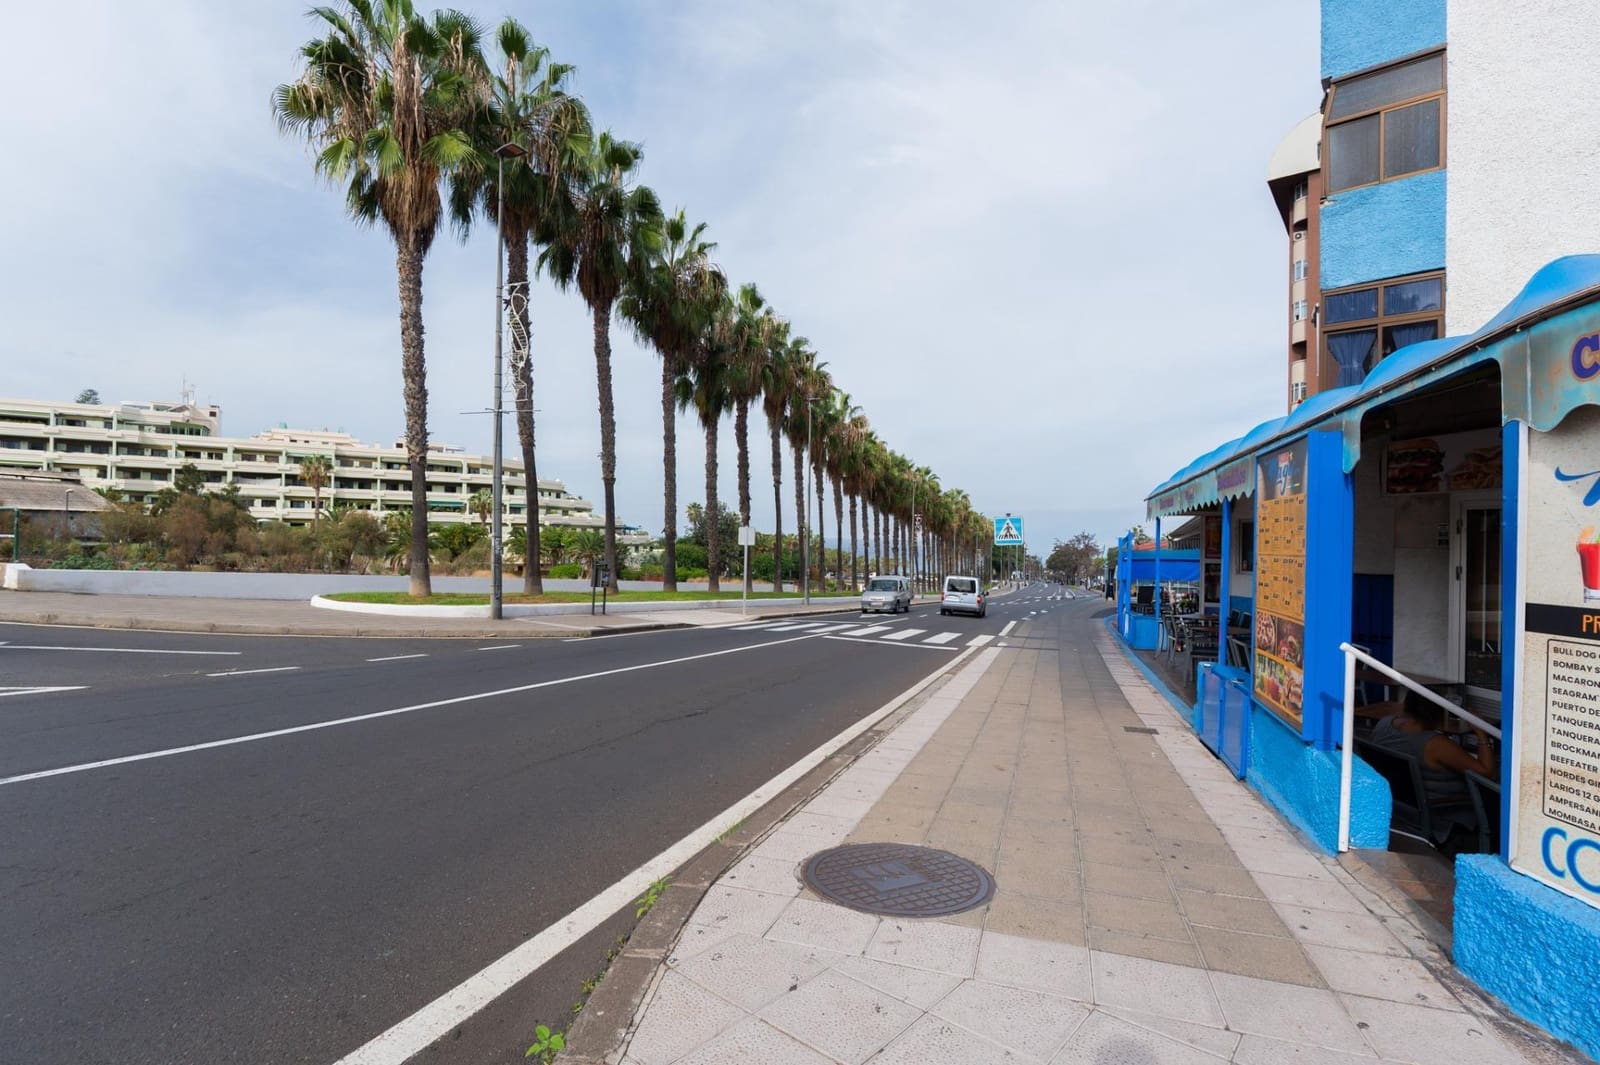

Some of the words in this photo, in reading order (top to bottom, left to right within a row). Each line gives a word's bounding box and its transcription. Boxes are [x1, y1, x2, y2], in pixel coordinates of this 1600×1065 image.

[1553, 646, 1574, 656] BULL
[1575, 650, 1597, 659] DOG
[1552, 660, 1592, 673] BOMBAY
[1551, 700, 1587, 714] PUERTO
[1588, 707, 1600, 717] DE
[1551, 713, 1600, 731] TANQUERA
[1551, 727, 1600, 746] TANQUERA
[1550, 754, 1598, 774] BEEFEATER
[1549, 767, 1586, 784] NORDES
[1549, 780, 1581, 797] LARIOS
[1582, 790, 1592, 800] 12
[1548, 807, 1597, 831] MOMBASA
